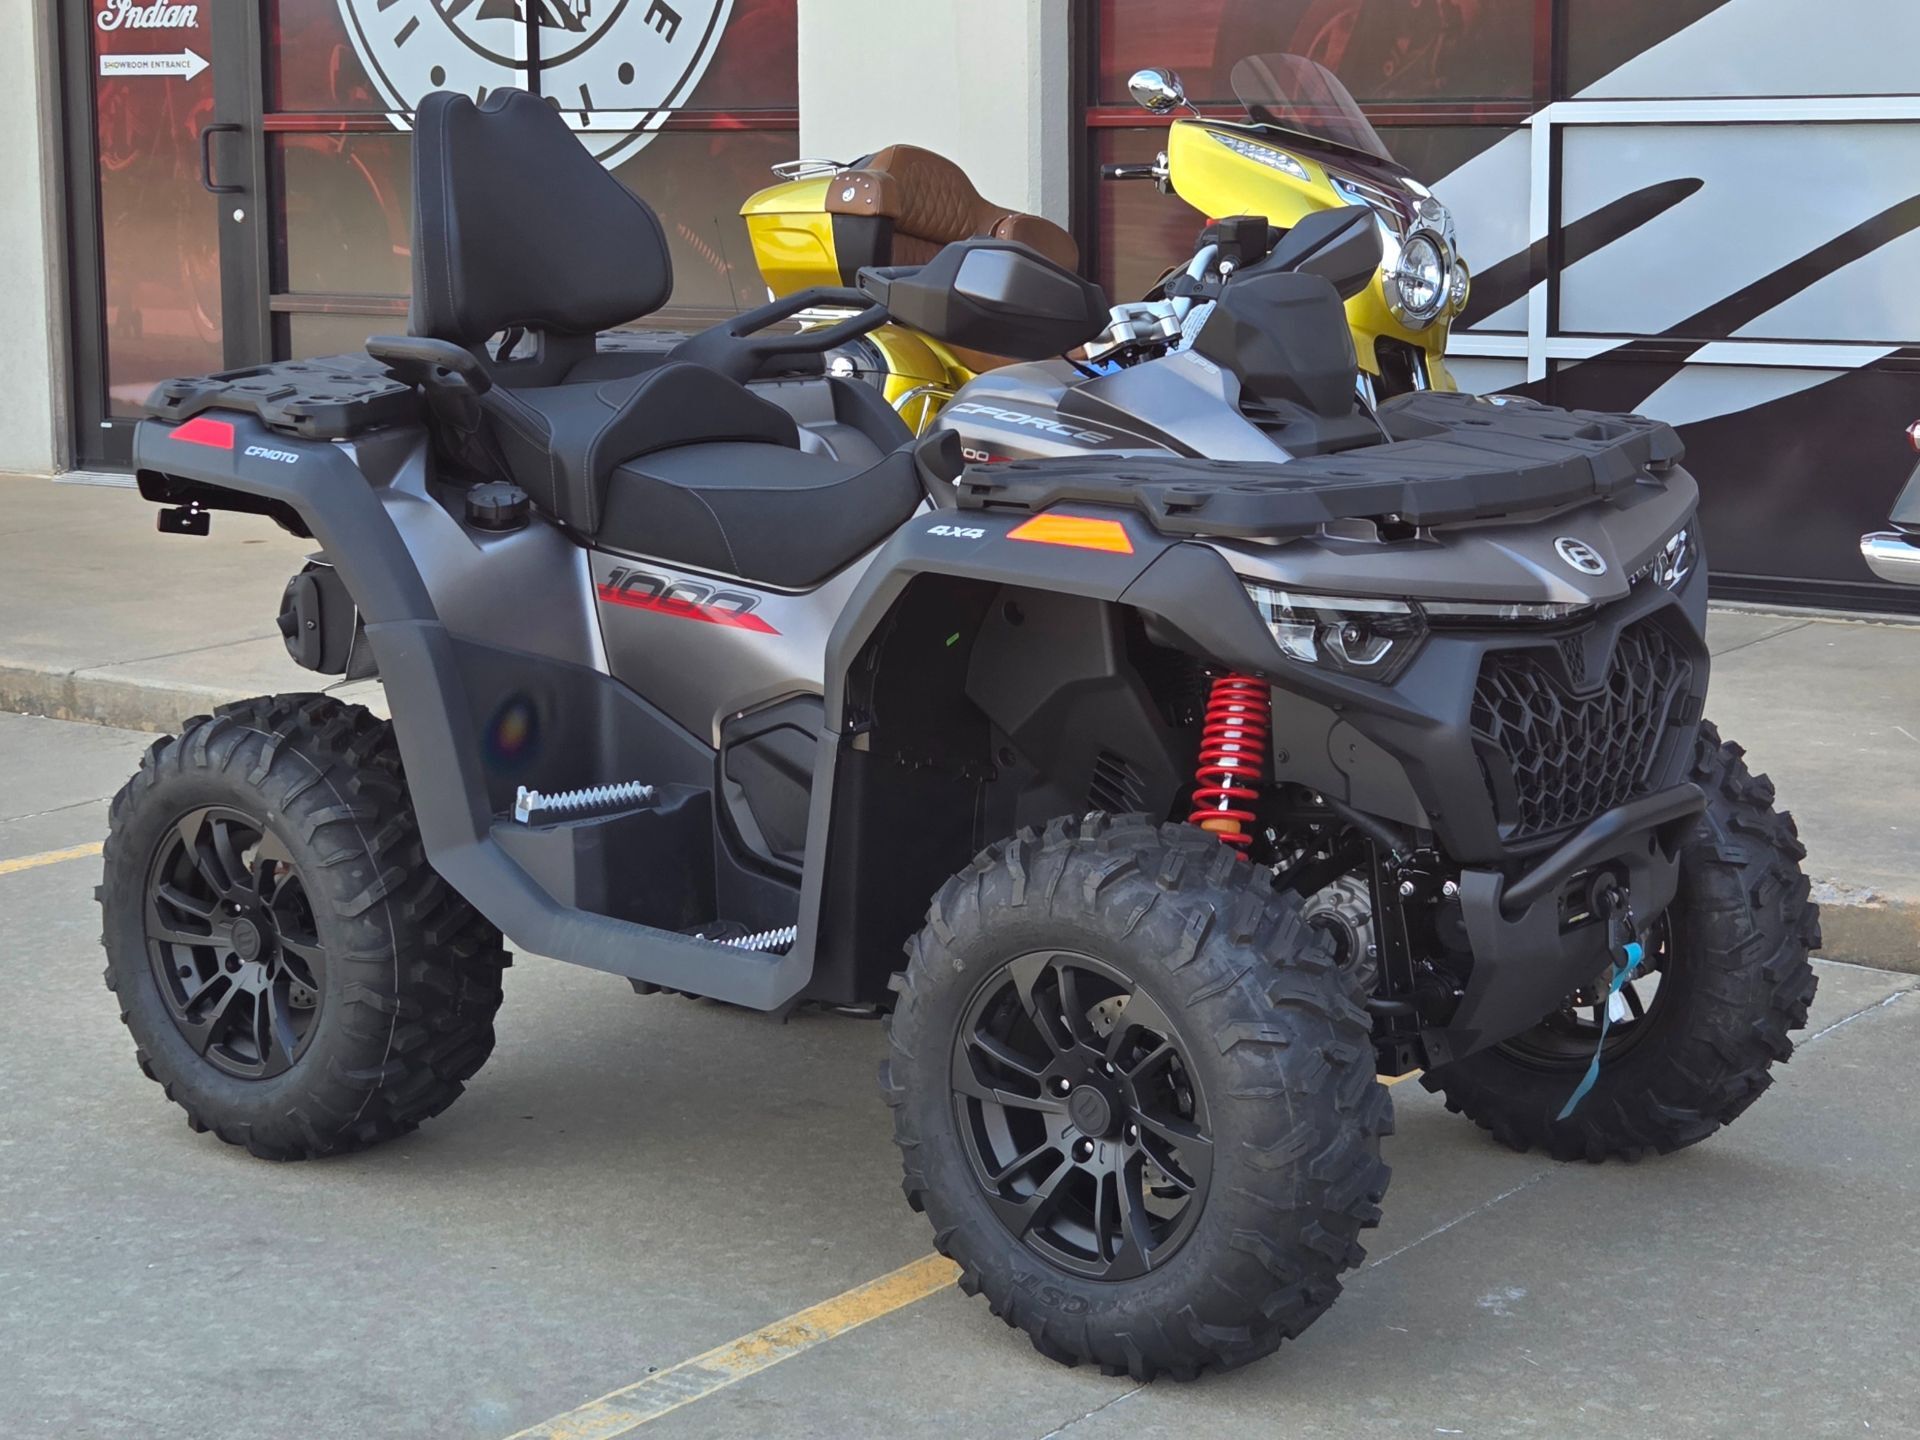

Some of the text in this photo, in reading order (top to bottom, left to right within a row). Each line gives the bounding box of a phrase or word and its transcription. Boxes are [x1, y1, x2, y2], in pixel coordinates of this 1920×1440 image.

[104, 60, 191, 69] SHOWROOM ENTRANCE
[949, 402, 1114, 444] CFORCE
[244, 445, 299, 463] CFMOTO
[606, 566, 762, 619] 1000
